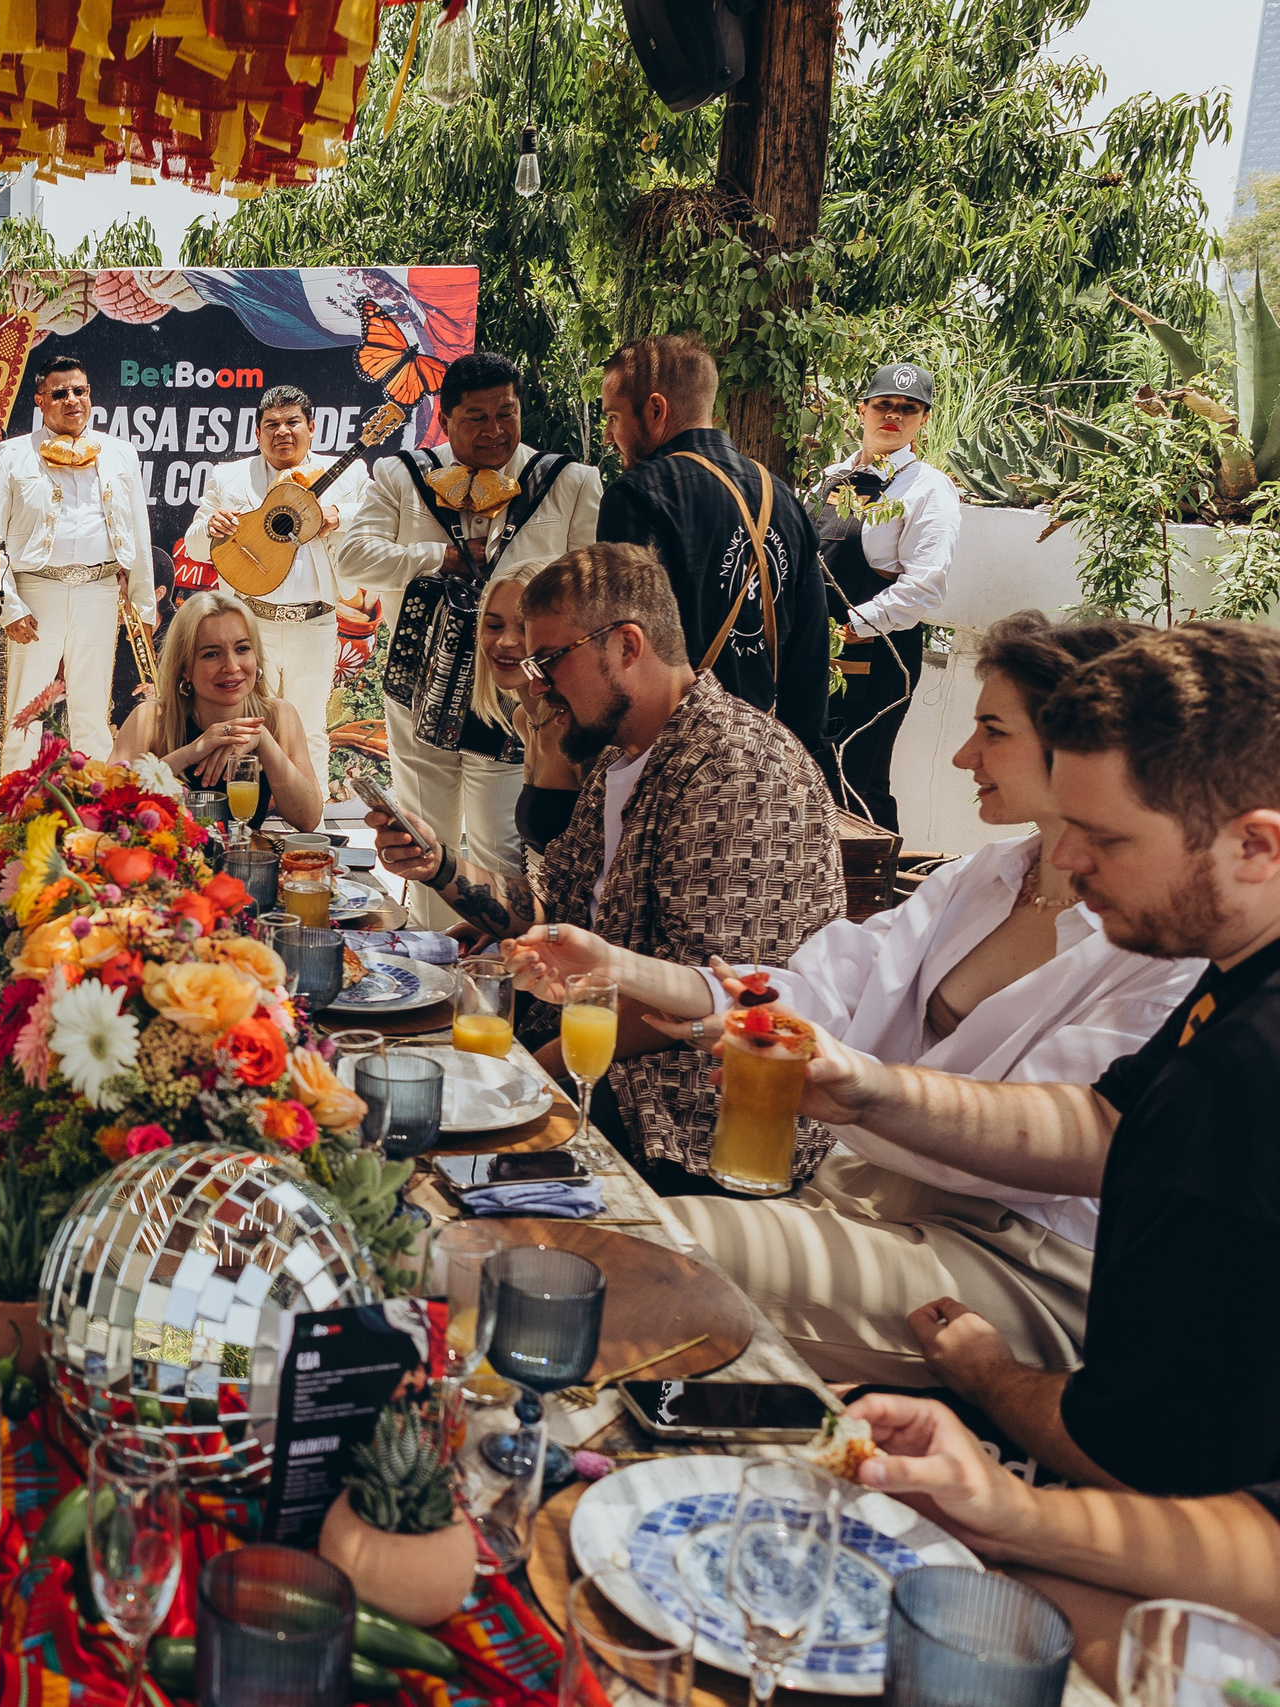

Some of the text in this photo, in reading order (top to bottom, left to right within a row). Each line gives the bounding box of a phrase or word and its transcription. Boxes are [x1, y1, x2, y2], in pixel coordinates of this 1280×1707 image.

[120, 360, 264, 388] BetBoom
[185, 406, 232, 452] ES
[235, 406, 361, 452] DDE
[448, 651, 474, 716] GABBANELLI
